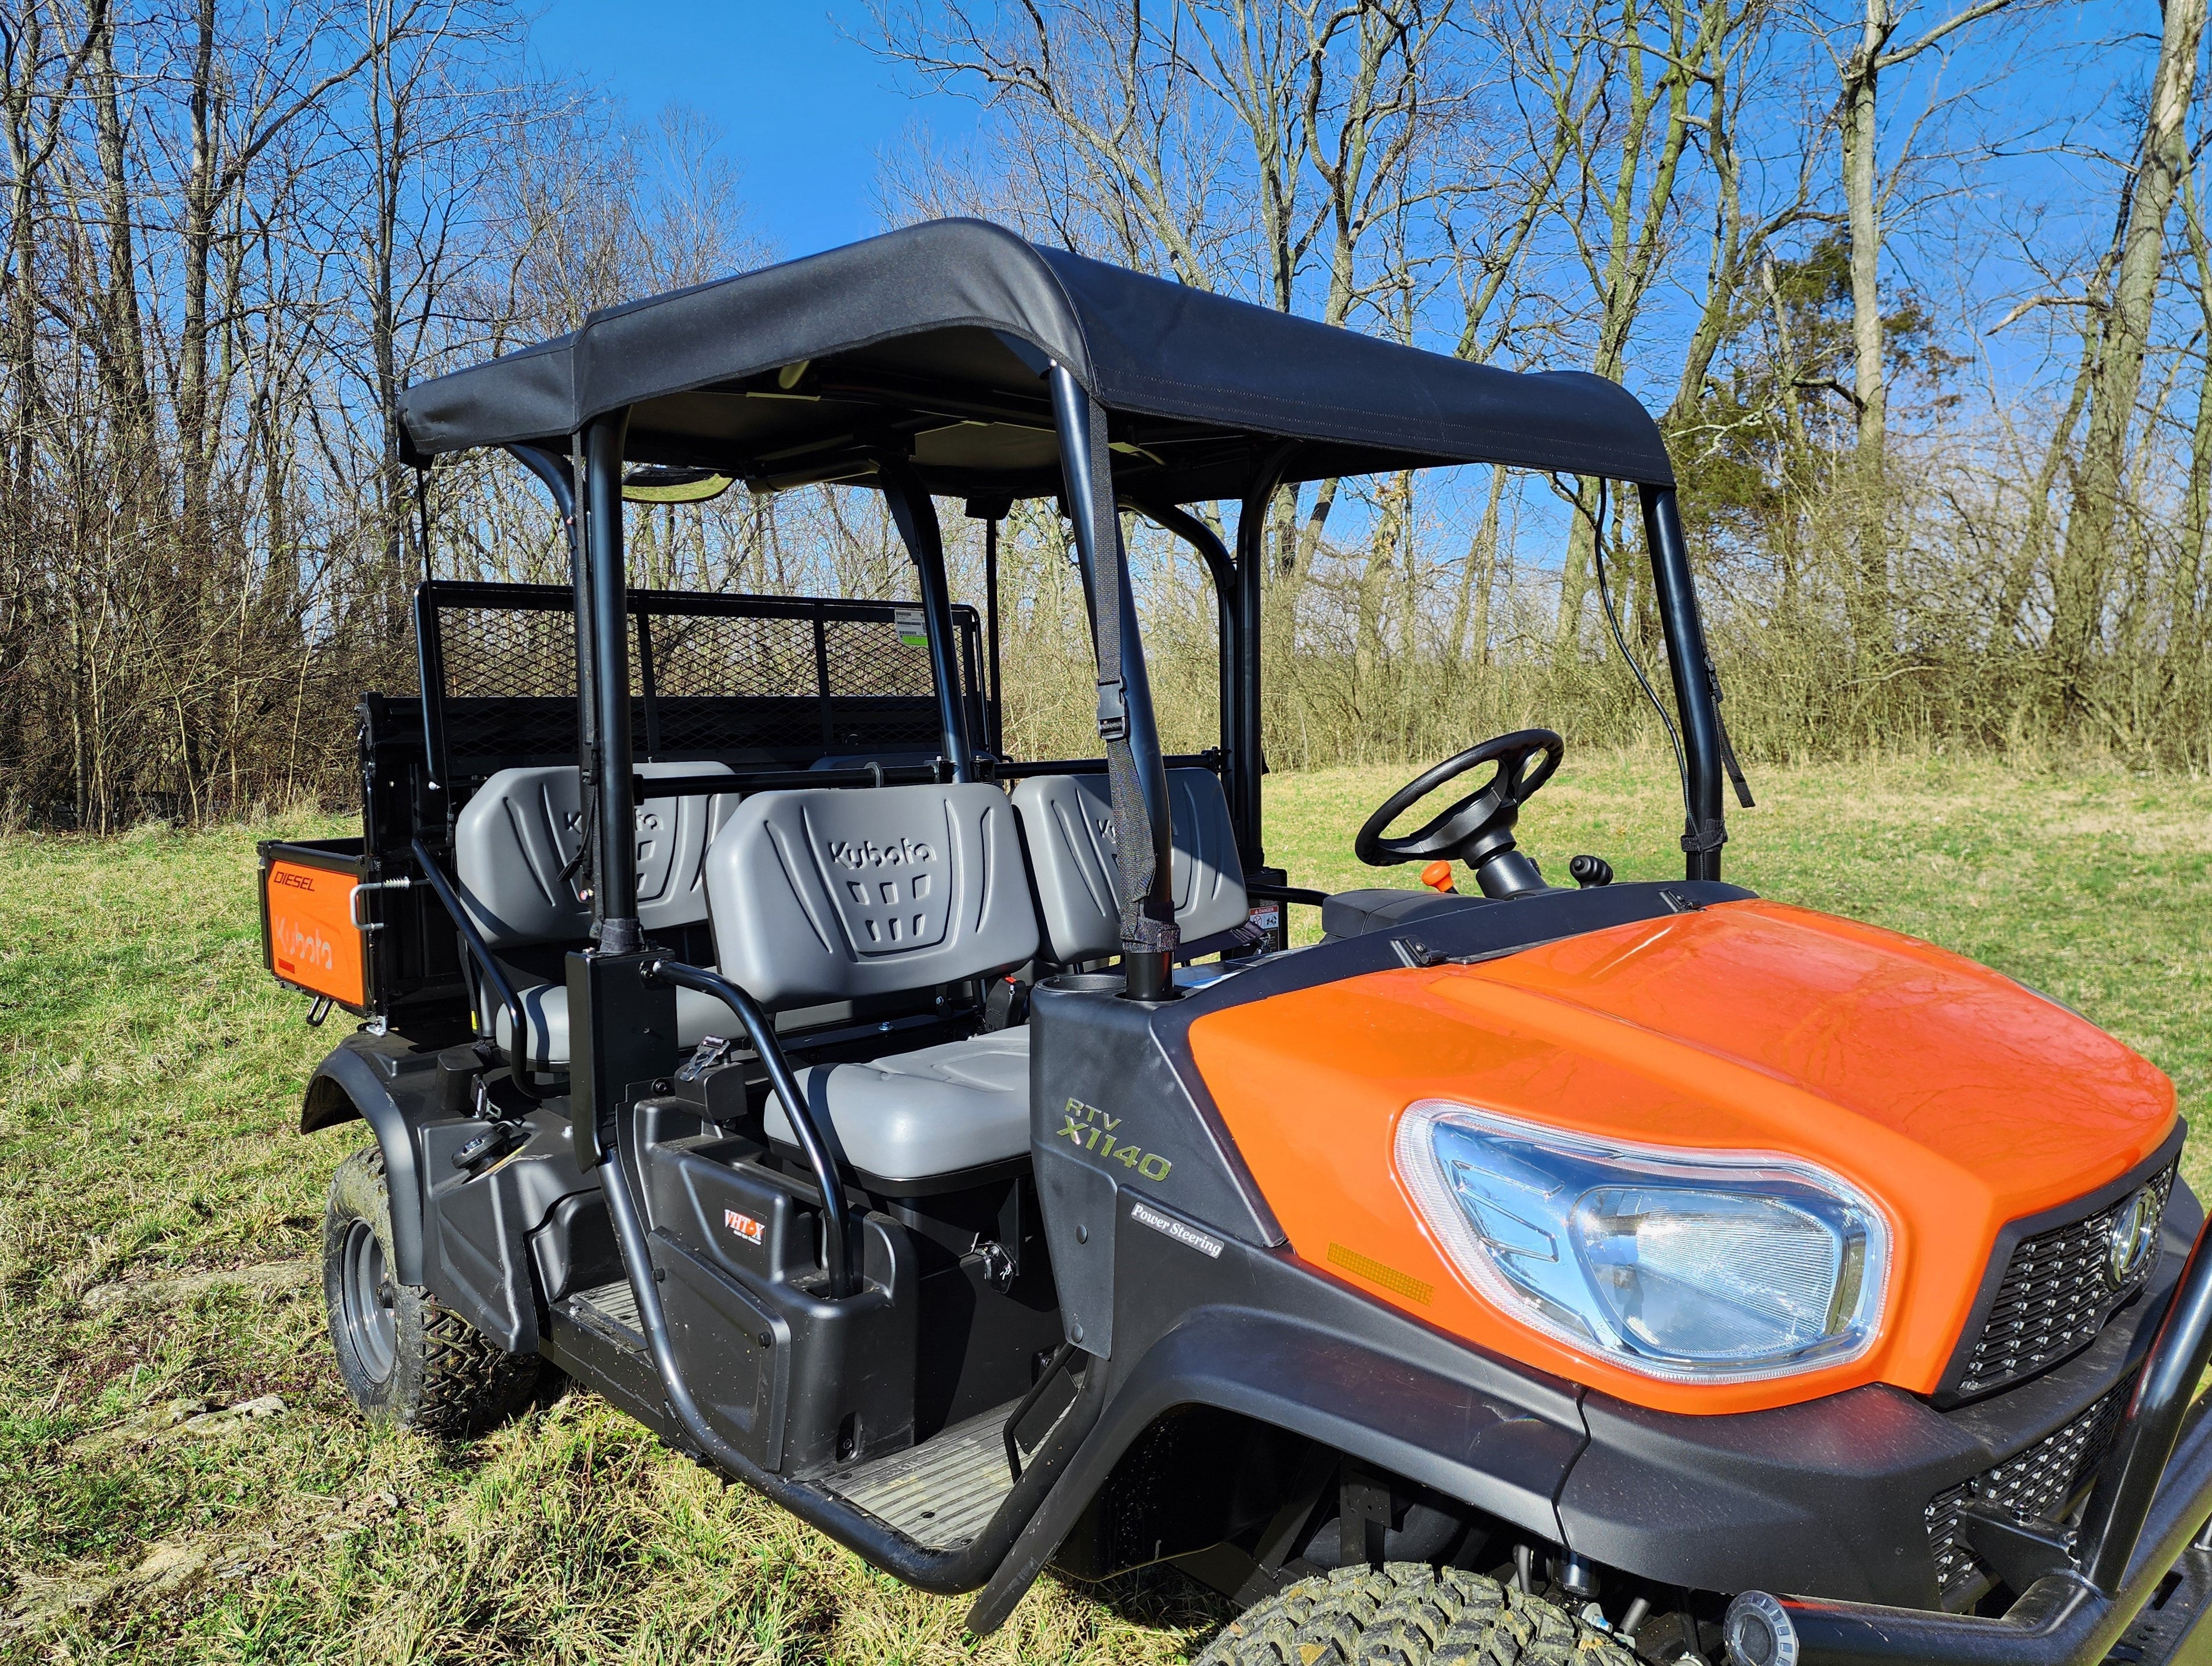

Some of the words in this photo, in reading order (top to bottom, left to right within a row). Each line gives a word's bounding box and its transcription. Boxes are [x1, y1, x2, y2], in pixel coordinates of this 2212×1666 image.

[828, 837, 937, 870] Kubota
[273, 871, 315, 891] DIESEL
[275, 914, 332, 970] Kubota
[1065, 1097, 1122, 1131] RTV
[1056, 1115, 1172, 1181] X1140
[1132, 1204, 1170, 1229] Power
[1169, 1222, 1222, 1255] Steering
